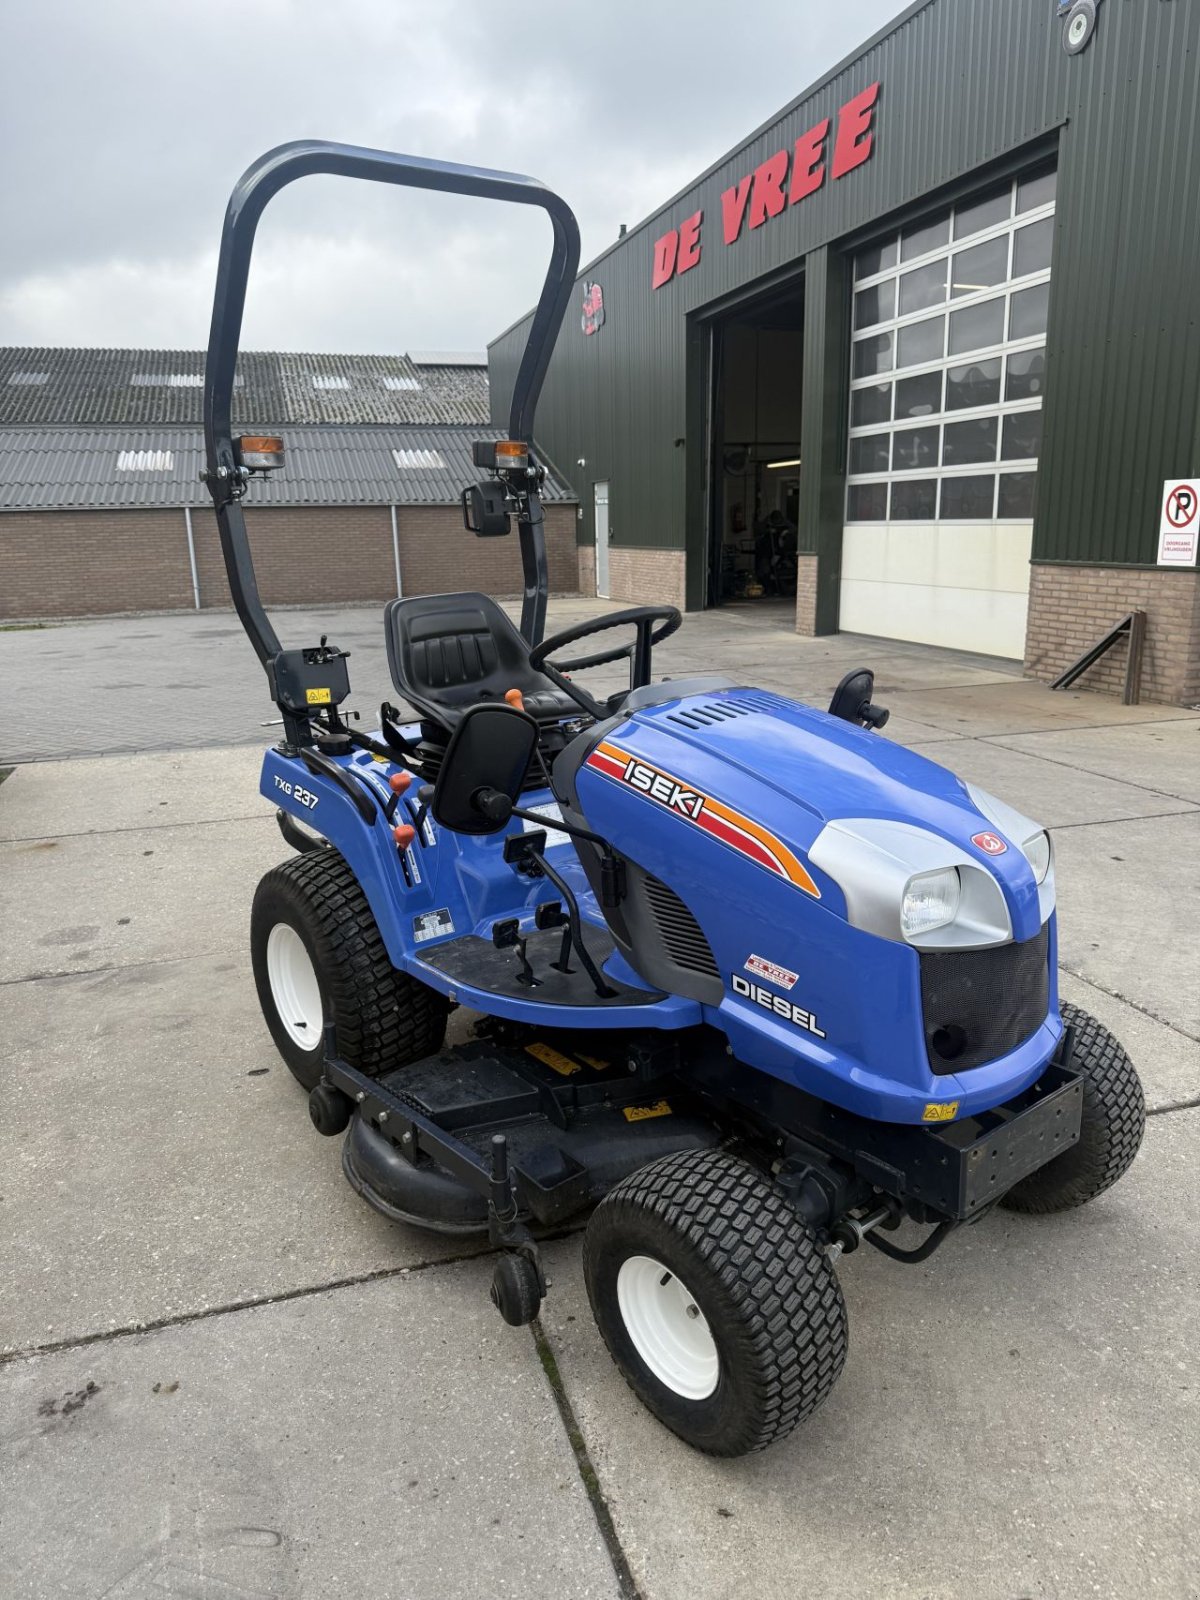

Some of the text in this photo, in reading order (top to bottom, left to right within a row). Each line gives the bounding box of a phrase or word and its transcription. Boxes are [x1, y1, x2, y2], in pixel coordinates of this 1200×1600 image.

[652, 81, 881, 290] DE VREE
[273, 775, 319, 809] TXG 237
[623, 760, 704, 819] ISEKI
[732, 974, 826, 1038] DIESEL
